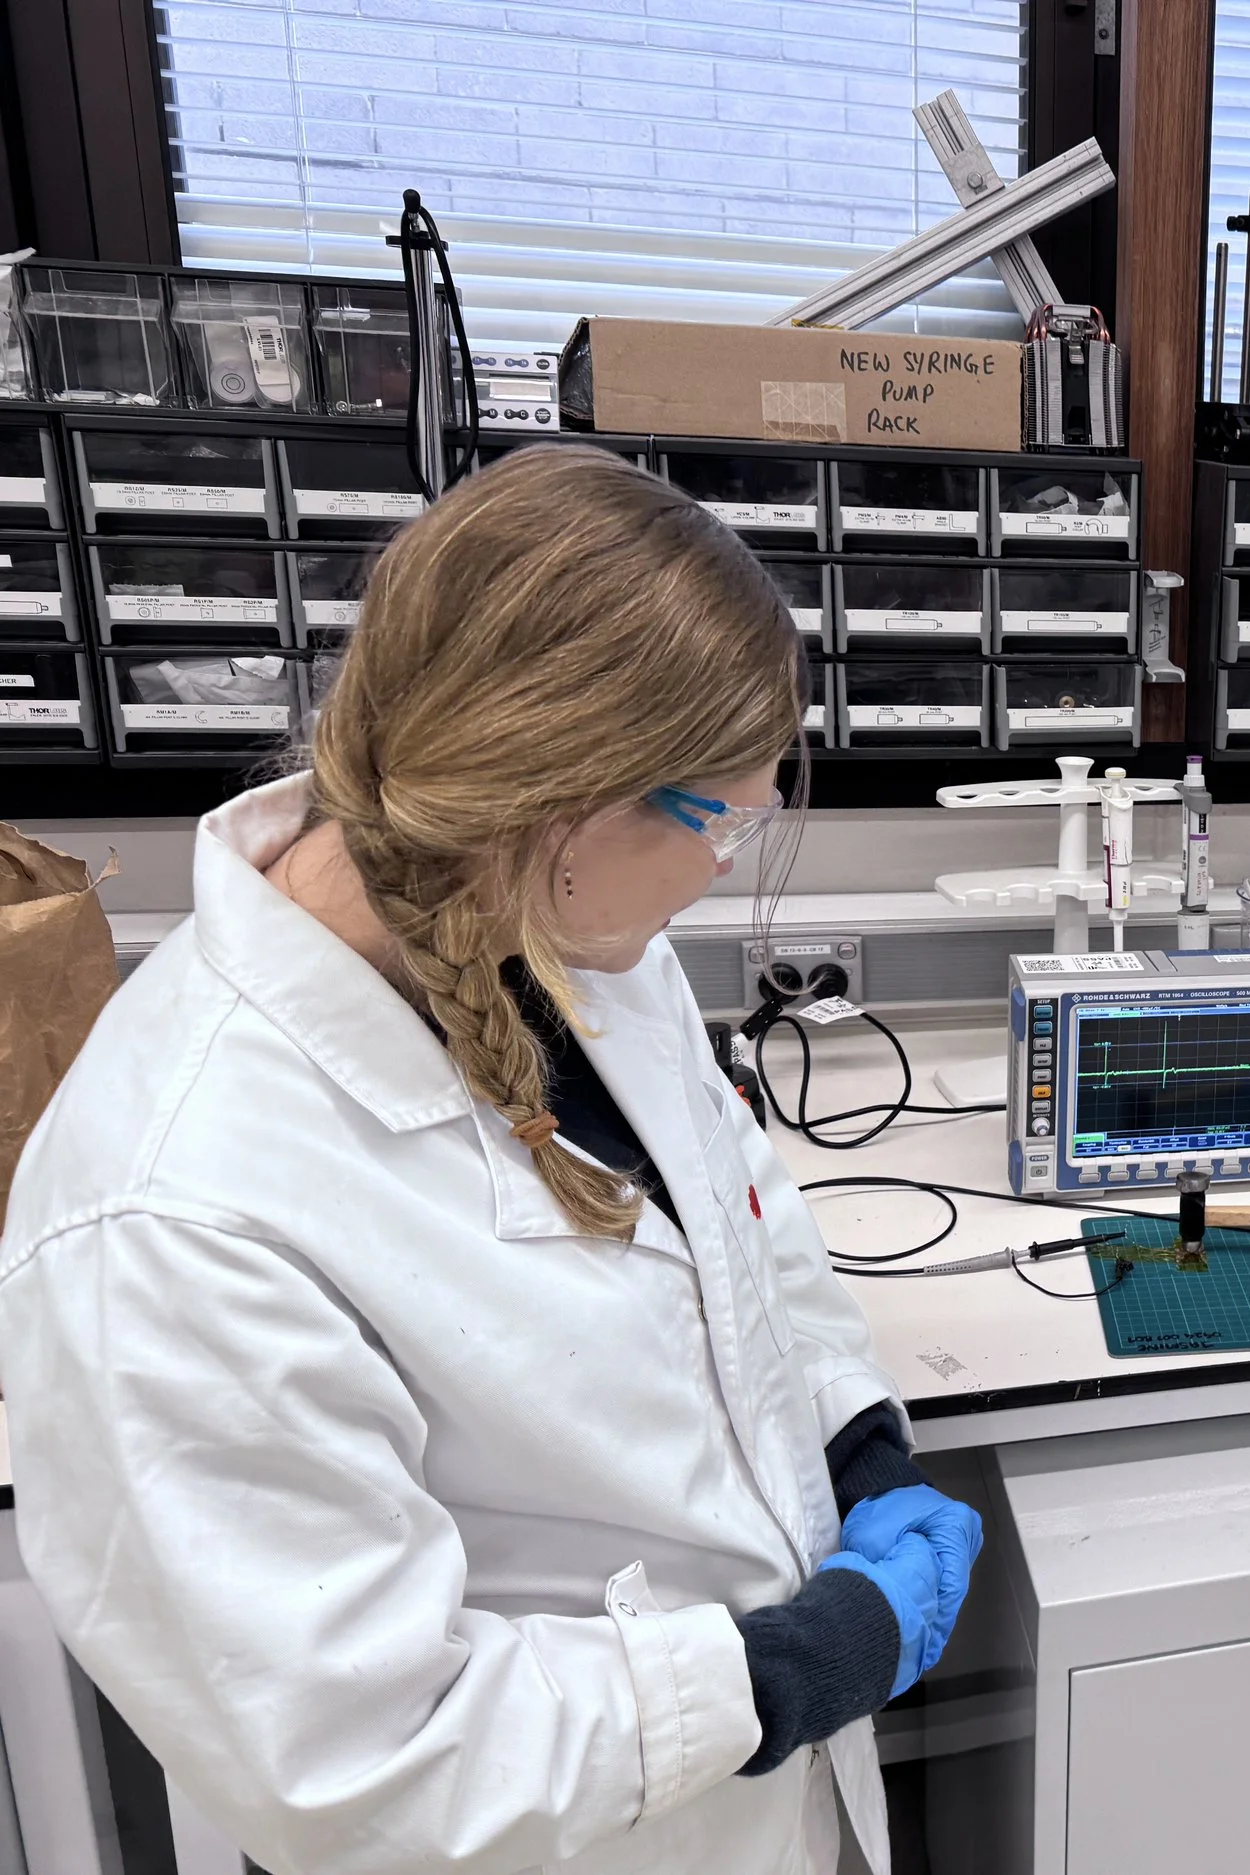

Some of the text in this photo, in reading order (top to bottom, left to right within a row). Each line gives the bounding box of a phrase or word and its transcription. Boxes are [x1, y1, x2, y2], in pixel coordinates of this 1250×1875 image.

[840, 348, 995, 375] NEW SYRINGE
[882, 380, 934, 403] PUMP
[867, 408, 920, 434] RACK
[1137, 1341, 1214, 1351] JASMINE
